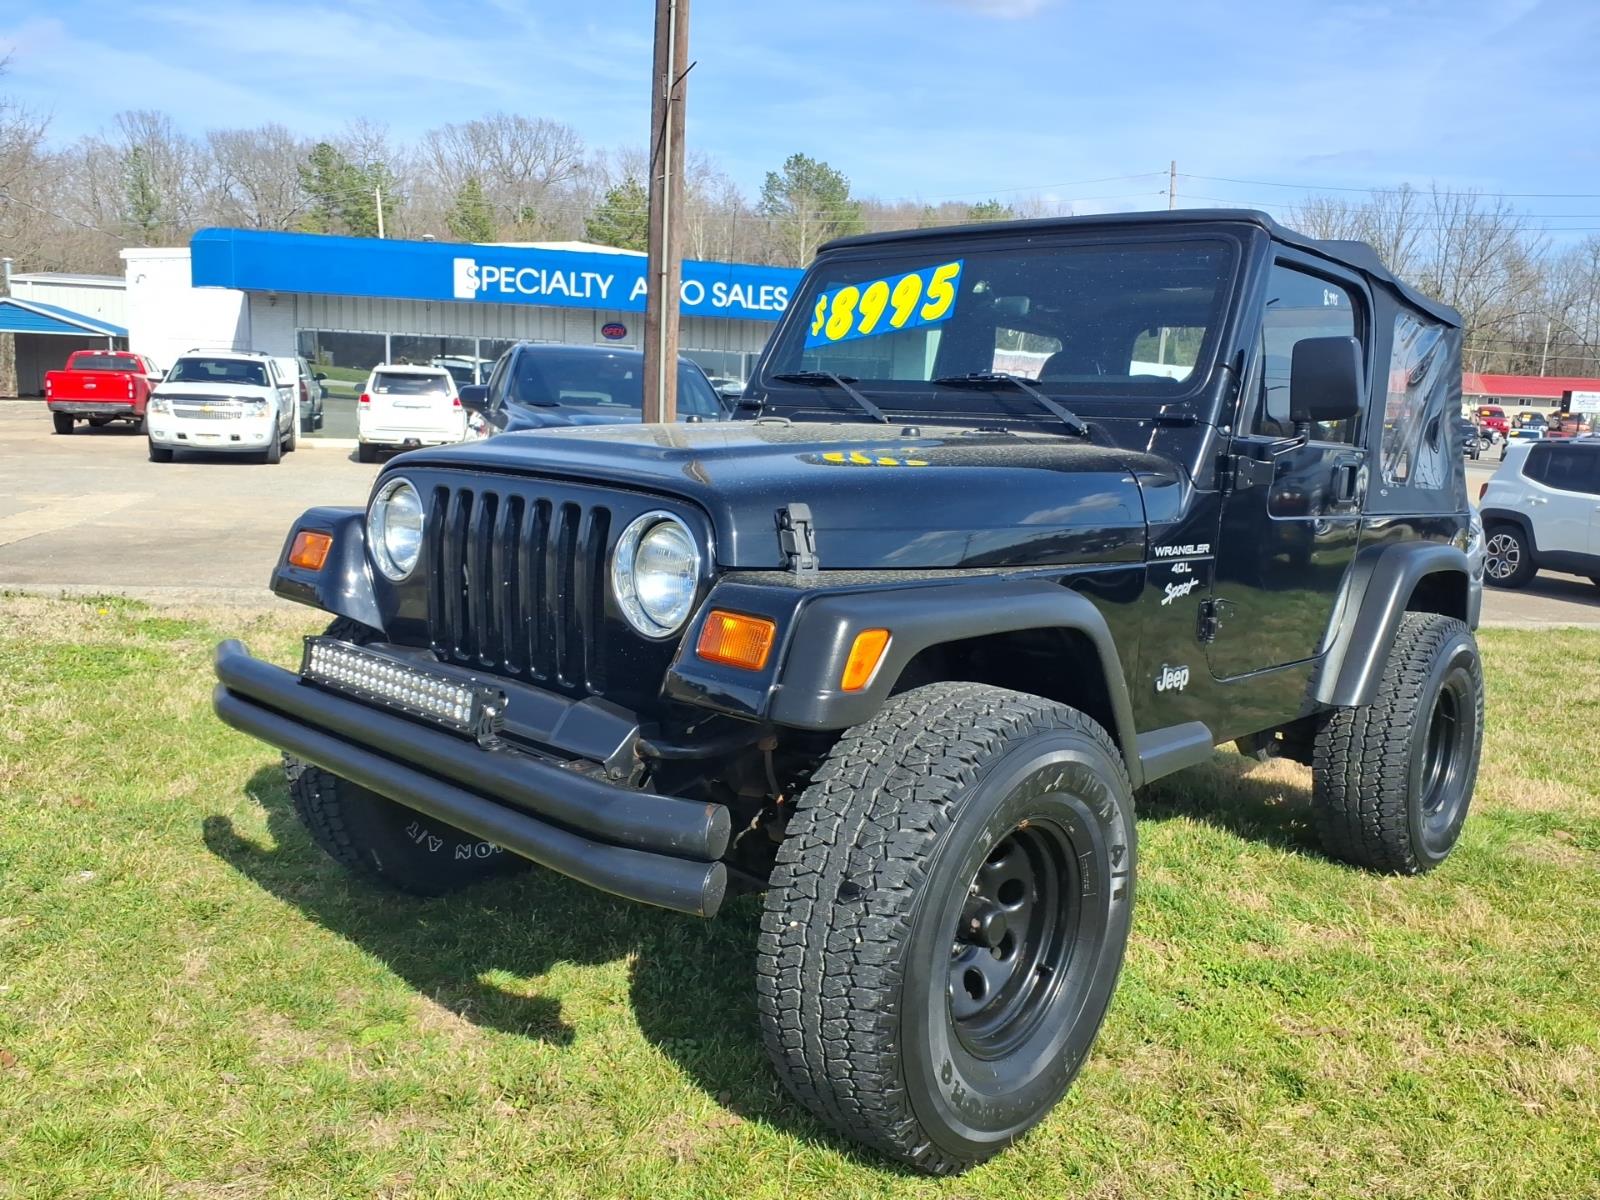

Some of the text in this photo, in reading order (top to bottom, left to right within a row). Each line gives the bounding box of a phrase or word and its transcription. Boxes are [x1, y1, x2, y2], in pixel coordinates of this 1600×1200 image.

[466, 264, 789, 311] SPECIALTY AO SALES
[811, 262, 961, 341] $8995
[1154, 543, 1211, 557] WRANGLER
[1161, 577, 1199, 606] Sport
[1155, 665, 1190, 692] Jeep
